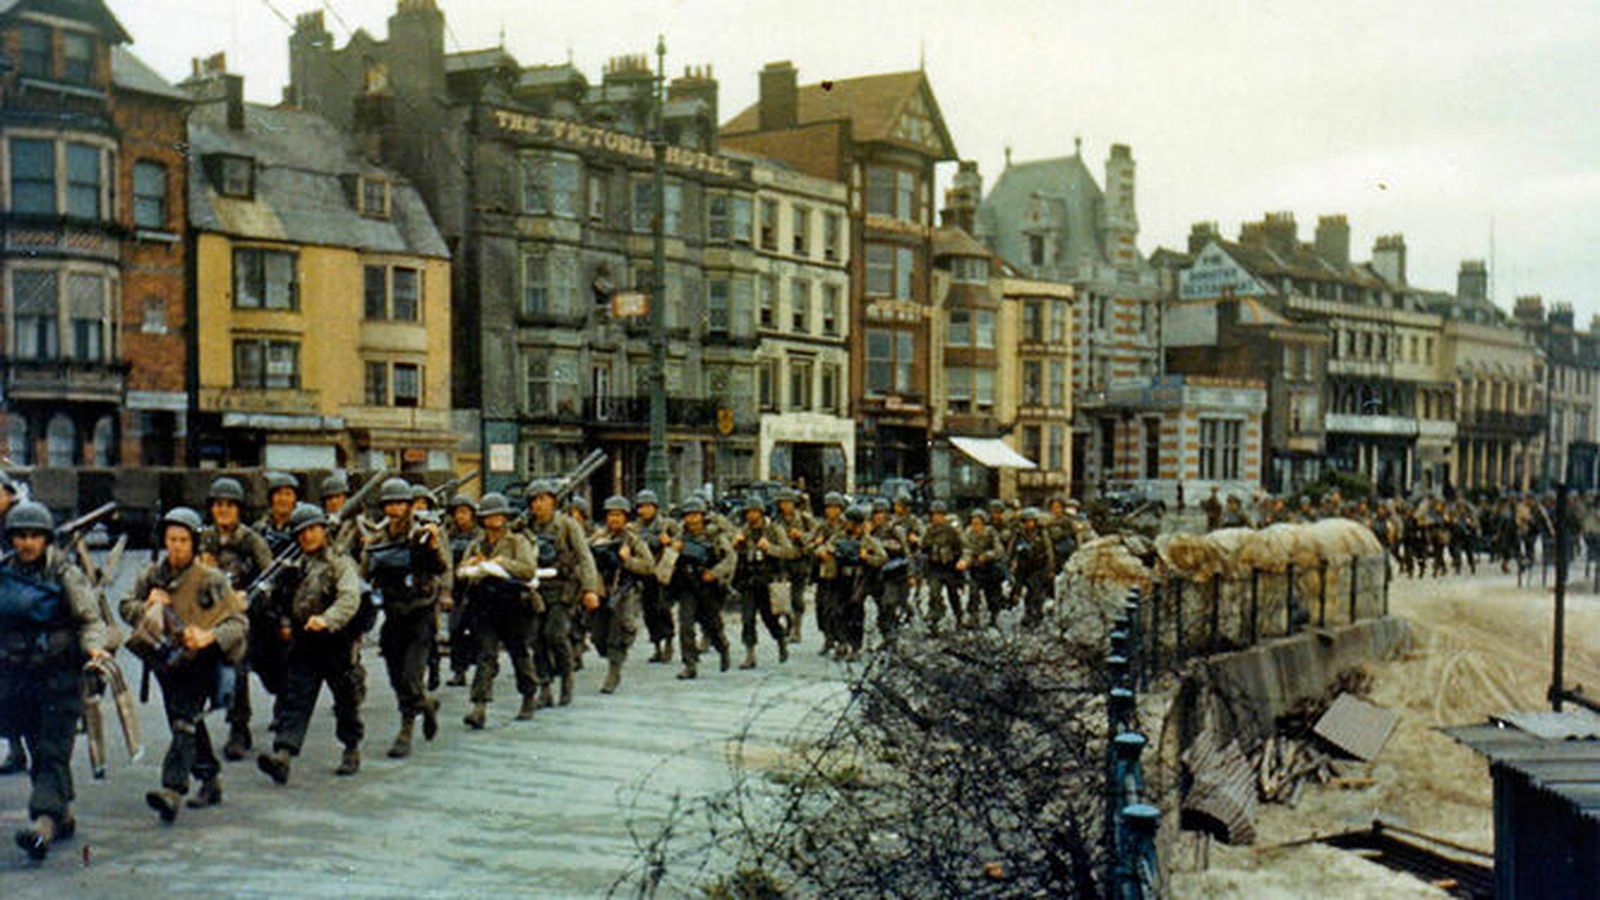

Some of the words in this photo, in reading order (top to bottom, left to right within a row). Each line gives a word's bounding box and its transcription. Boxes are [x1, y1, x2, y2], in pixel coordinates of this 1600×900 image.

[495, 108, 540, 134] THE
[549, 119, 655, 159] VICTORIA
[665, 146, 738, 176] HOTEL
[1183, 279, 1255, 296] RESTAANT
